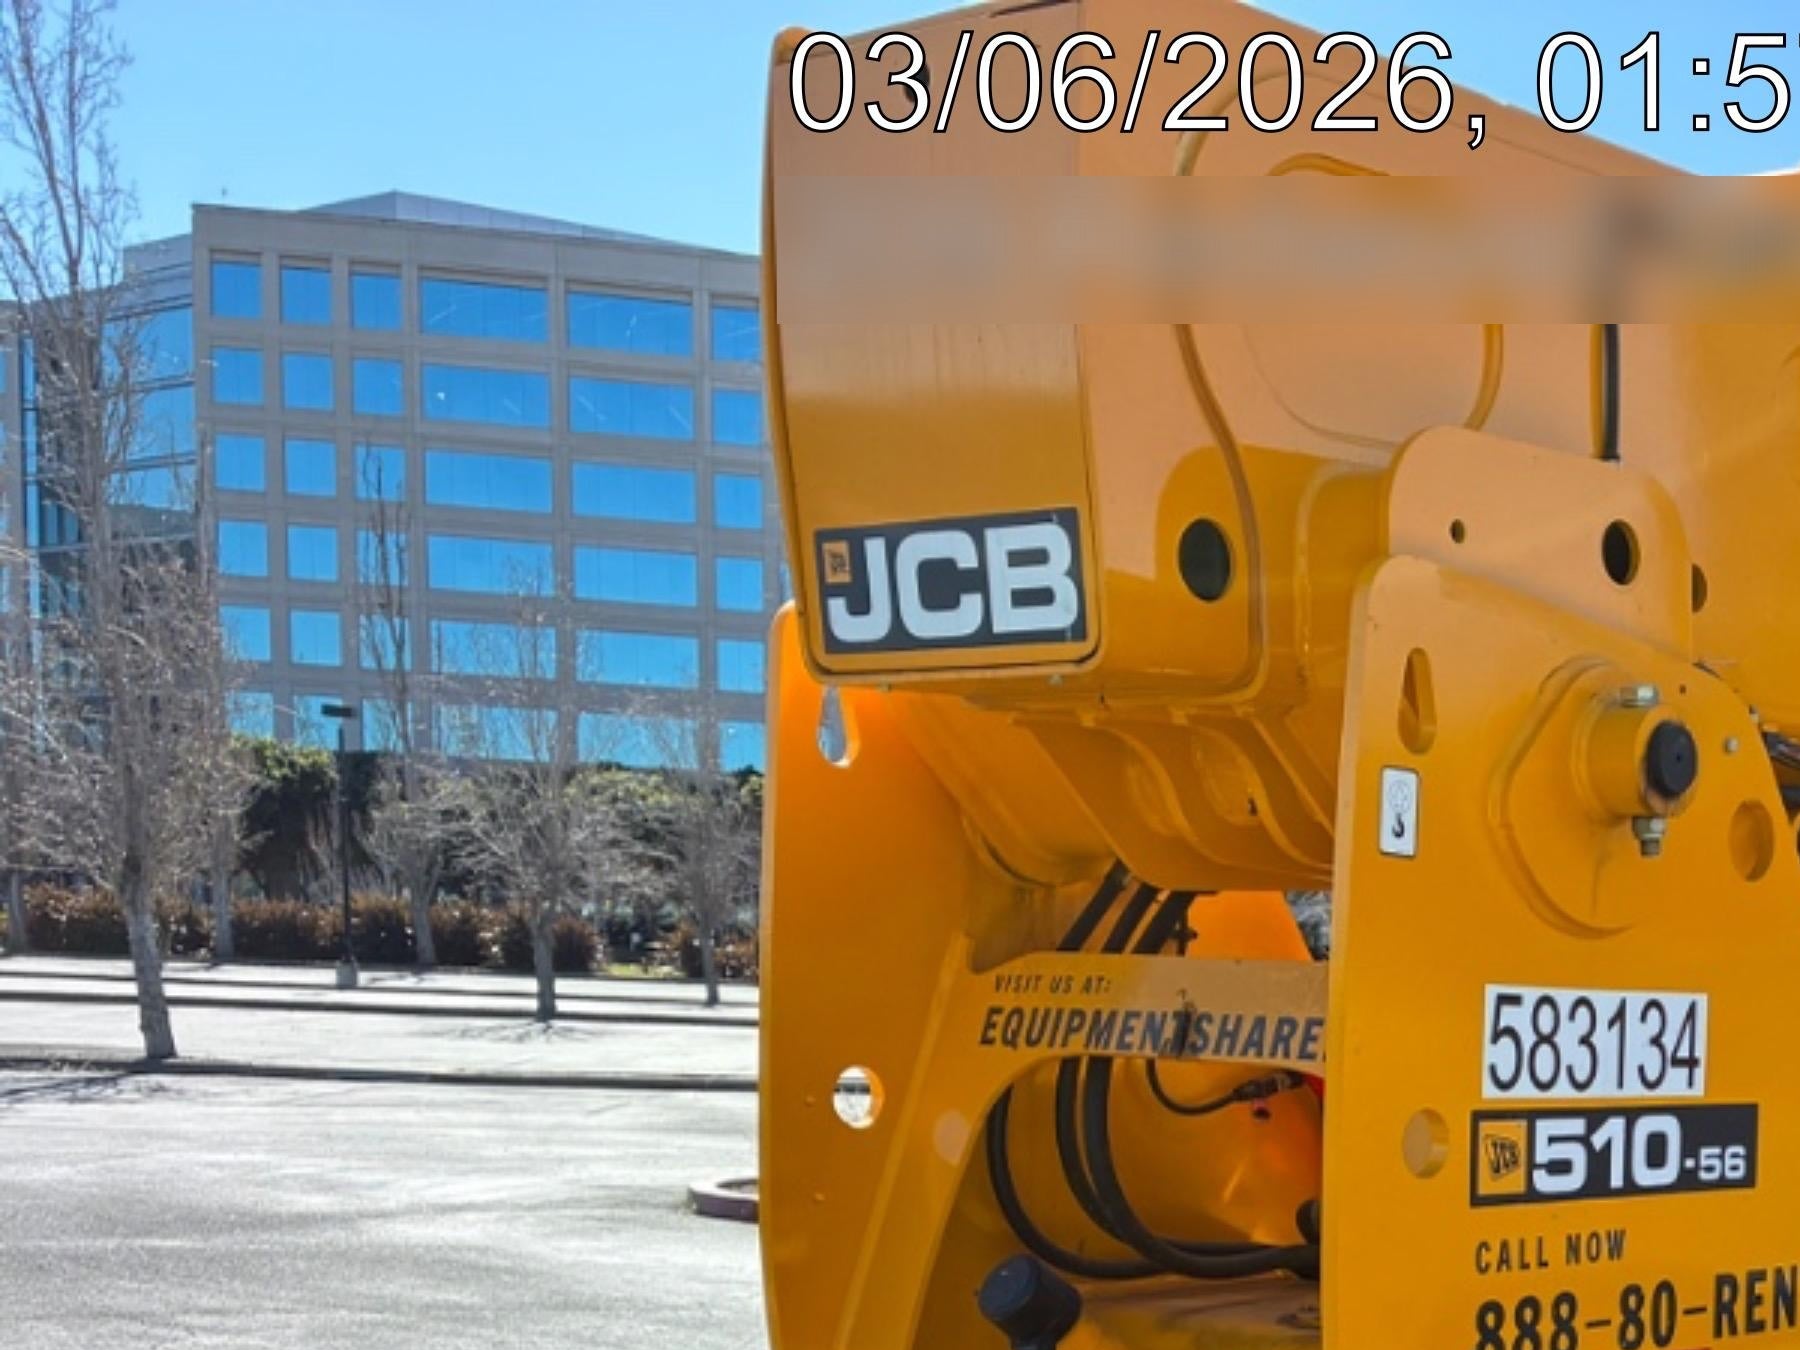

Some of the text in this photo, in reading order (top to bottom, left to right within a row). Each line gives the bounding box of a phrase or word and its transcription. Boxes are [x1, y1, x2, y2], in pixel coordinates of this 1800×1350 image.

[826, 523, 1080, 644] JCB
[994, 974, 1041, 994] VISIT
[1050, 977, 1073, 993] US
[1488, 994, 1700, 1092] 583134
[1475, 1229, 1627, 1275] CALL NOW
